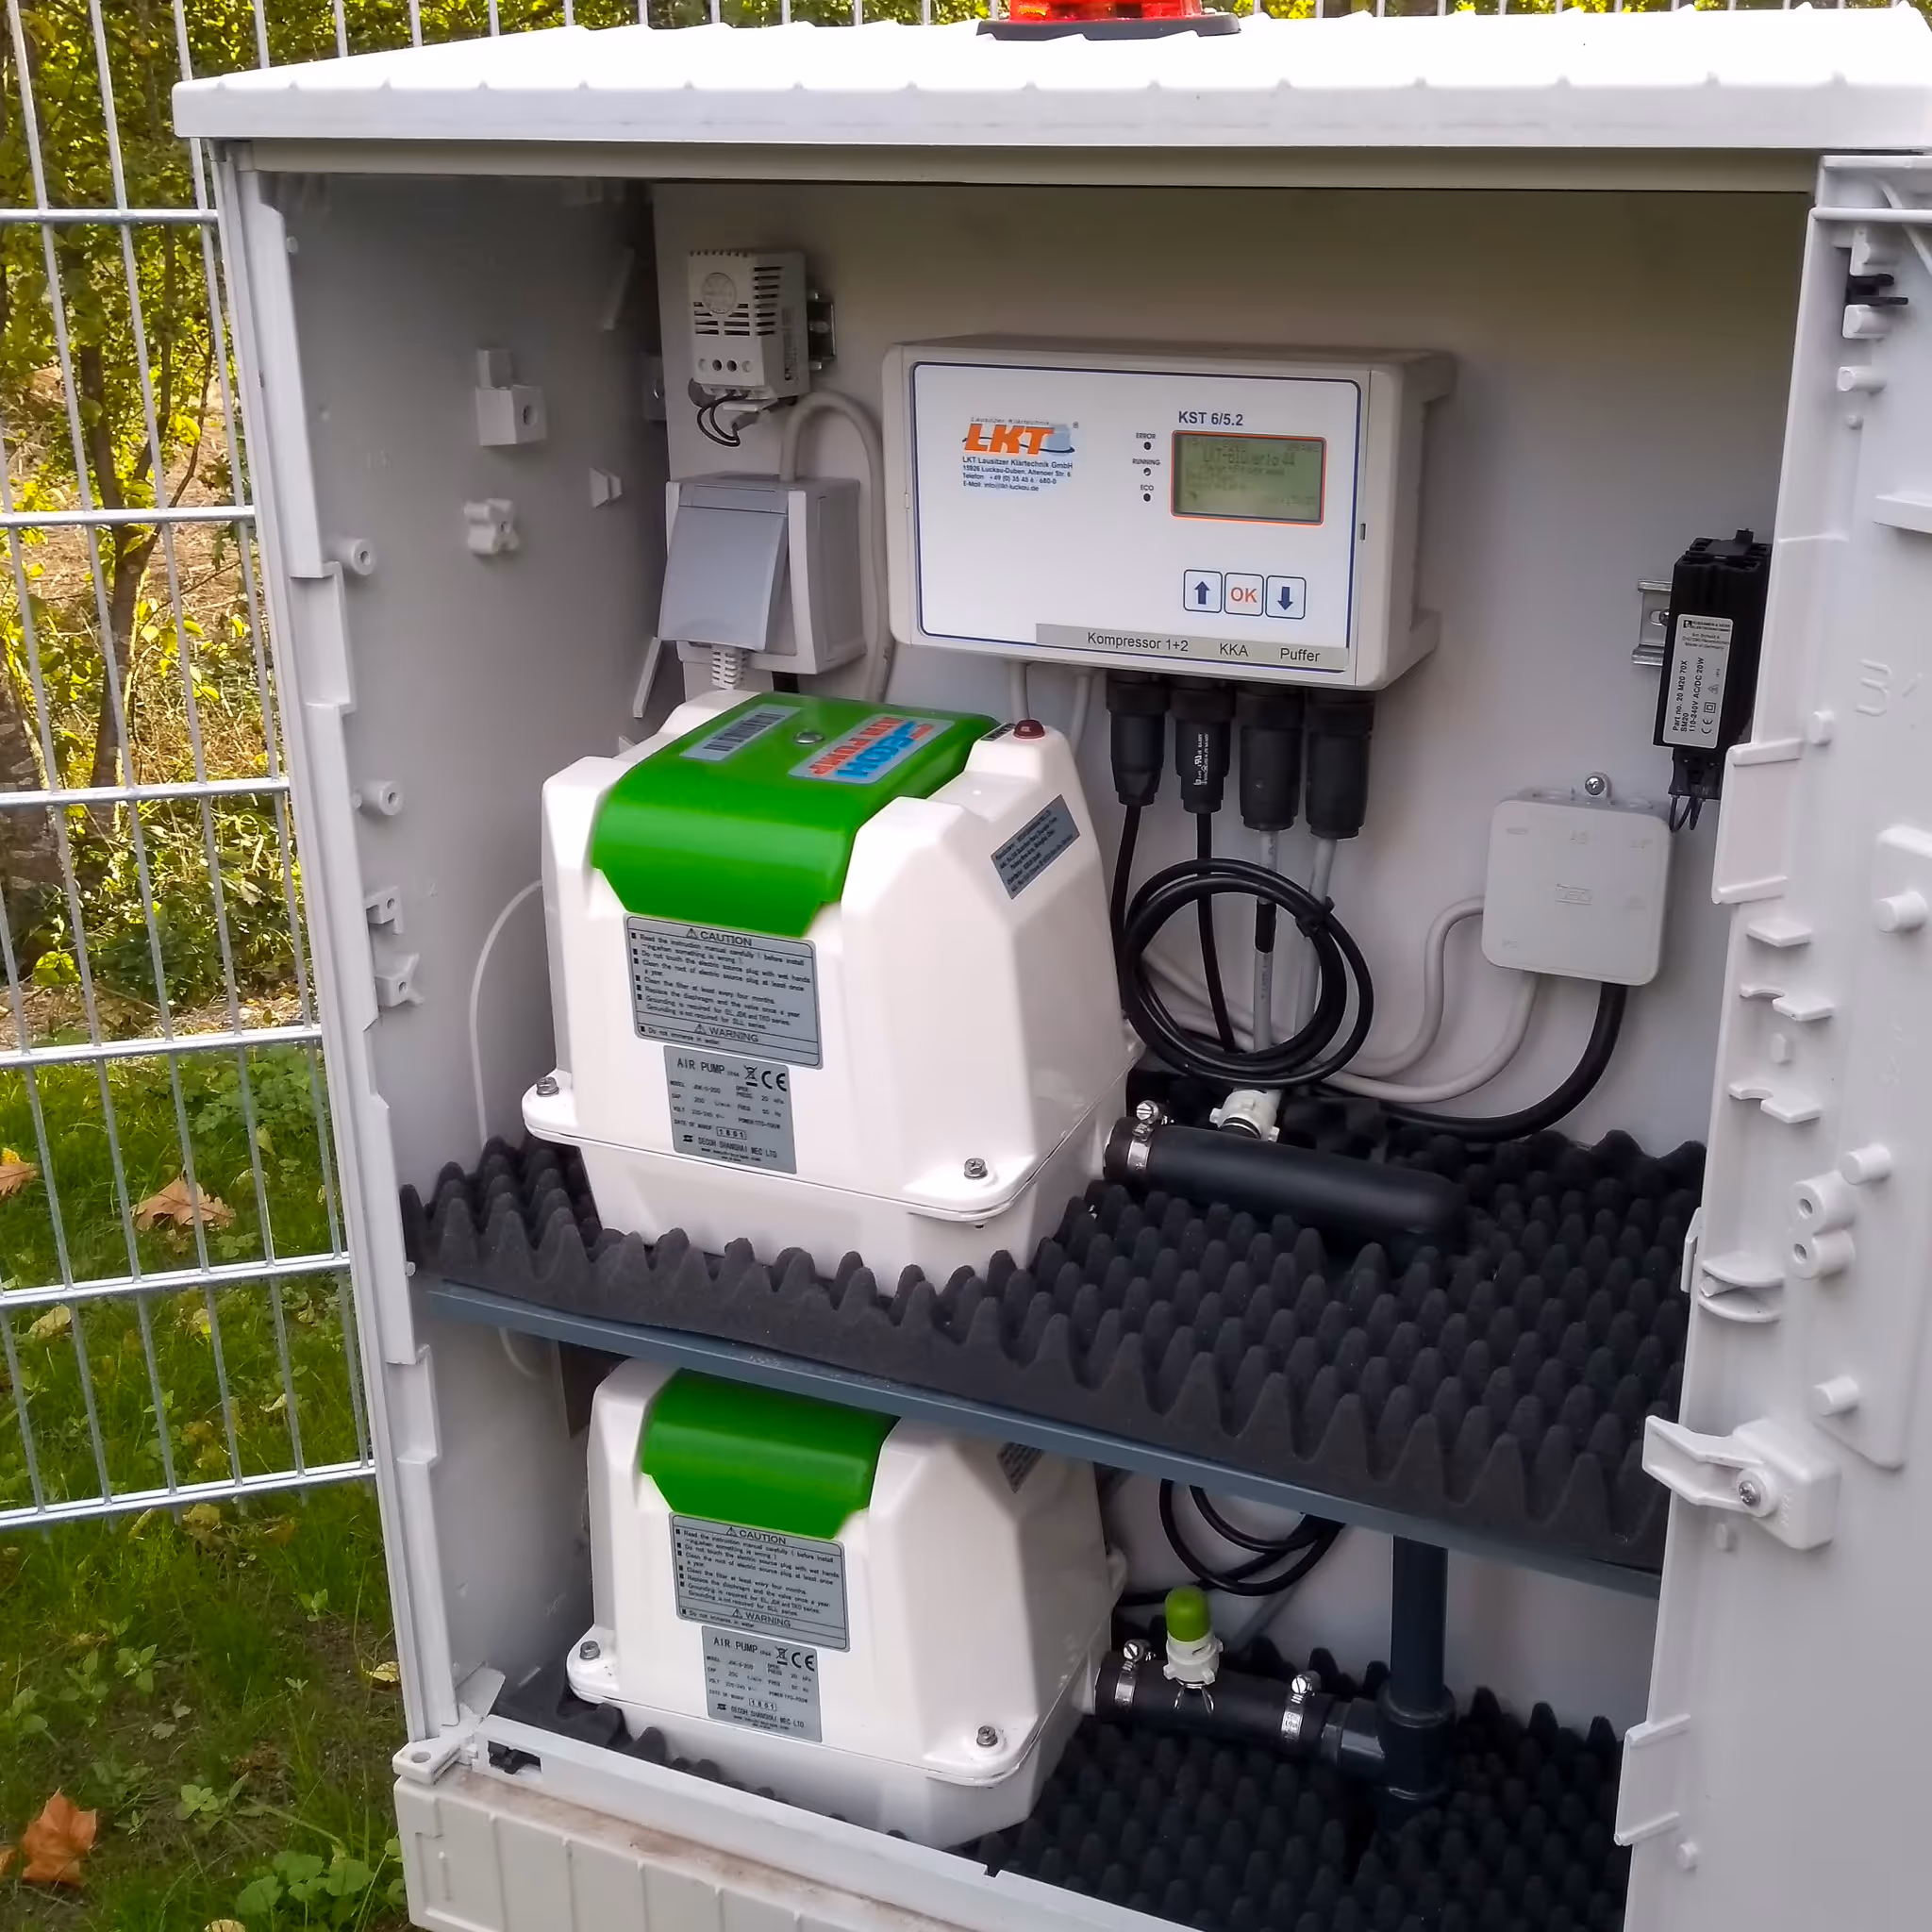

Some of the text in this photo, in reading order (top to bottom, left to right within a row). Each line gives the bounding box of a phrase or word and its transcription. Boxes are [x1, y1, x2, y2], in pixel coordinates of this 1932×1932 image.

[1178, 411, 1243, 426] KST 6/5.2
[964, 423, 1055, 455] LKT
[1051, 461, 1073, 469] GmbH
[1133, 458, 1161, 466] RUNNING
[1230, 586, 1258, 604] OK
[1087, 632, 1321, 662] Kompressor 1+2 KKA Puffer
[1678, 675, 1686, 691] M20
[1676, 693, 1683, 701] 20
[1689, 657, 1705, 732] 110-240V AC/DC 20W
[1673, 716, 1681, 731] Part
[1681, 713, 1689, 732] SM20
[700, 930, 751, 946] CAUTION
[709, 1026, 758, 1042] WARNING
[677, 1058, 725, 1074] AIR PUMP
[739, 1529, 786, 1544] CAUTION
[745, 1611, 791, 1627] WARNING
[714, 1637, 758, 1653] AIR PUMP
